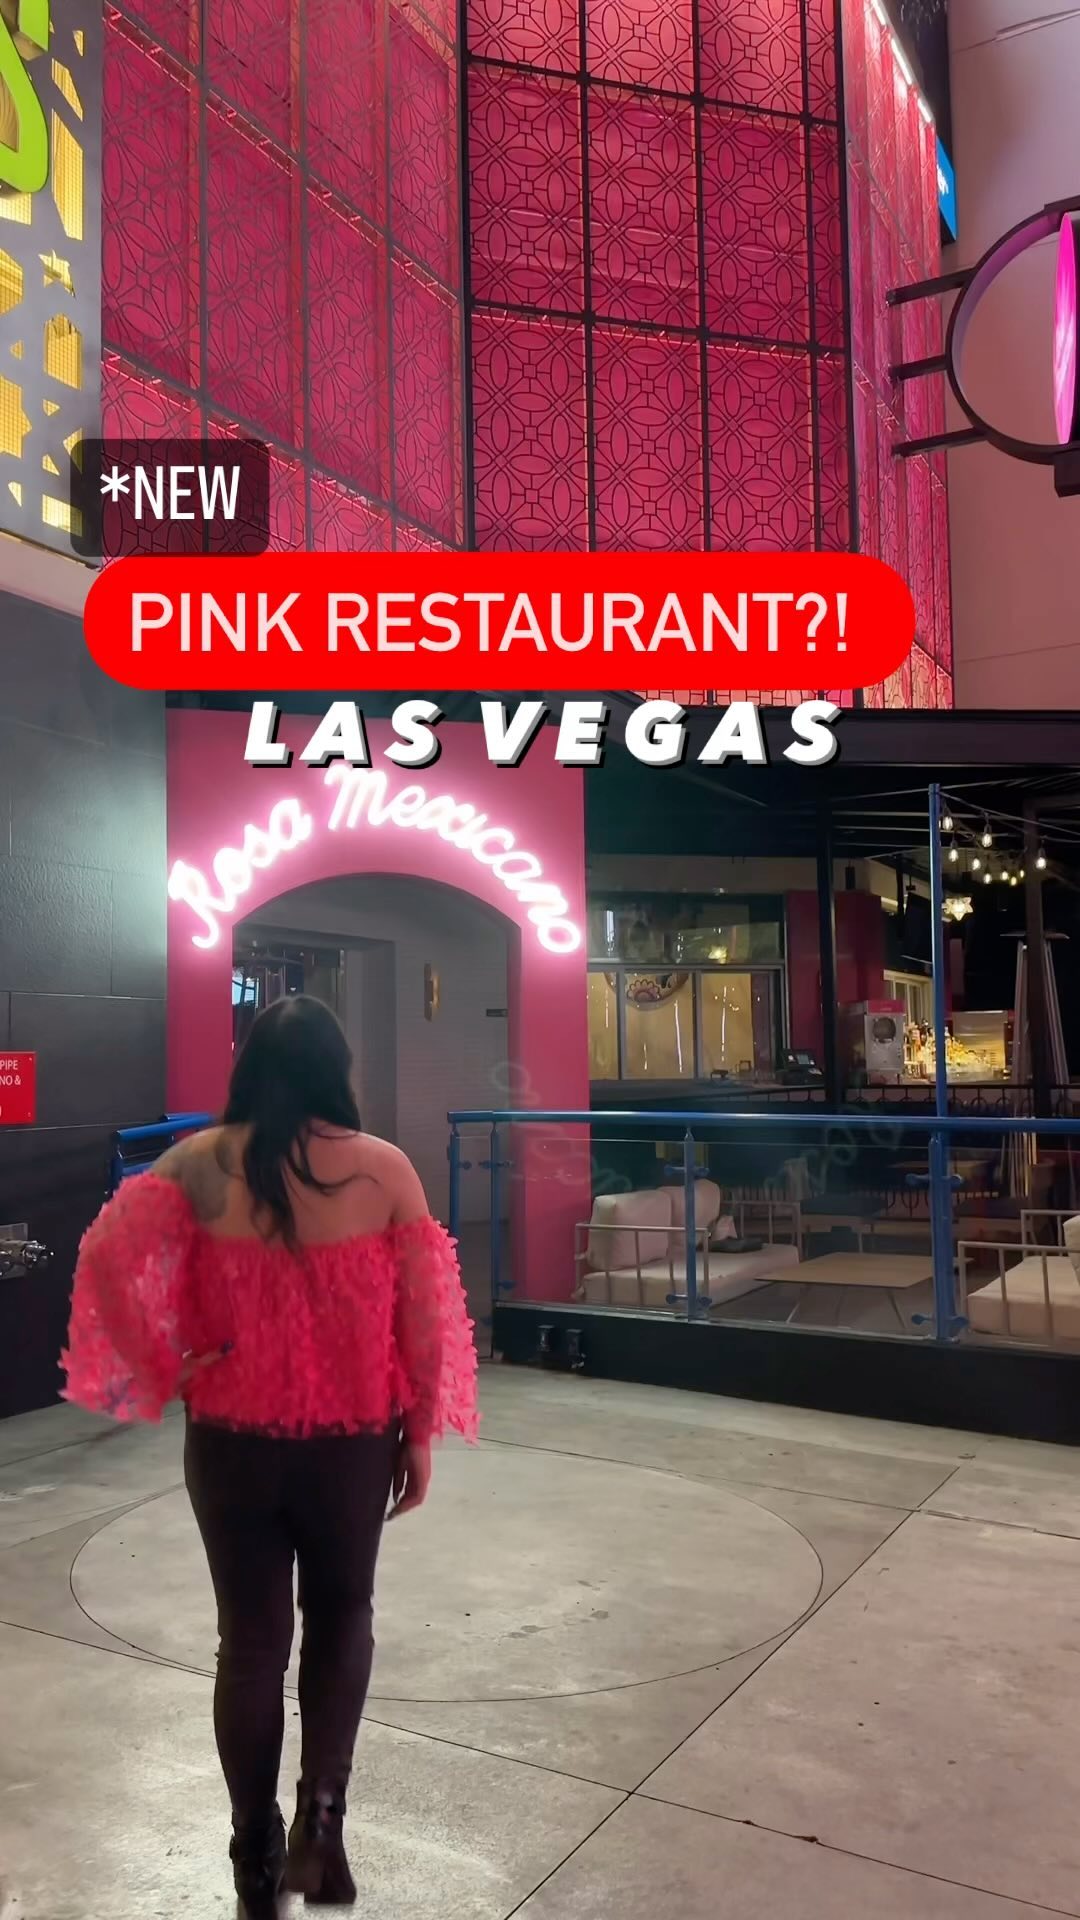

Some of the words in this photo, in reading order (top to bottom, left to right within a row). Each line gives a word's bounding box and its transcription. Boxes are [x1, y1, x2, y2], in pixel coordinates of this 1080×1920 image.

[168, 798, 312, 950] Rosa
[324, 764, 581, 954] Mexicano
[14, 1075, 21, 1086] &
